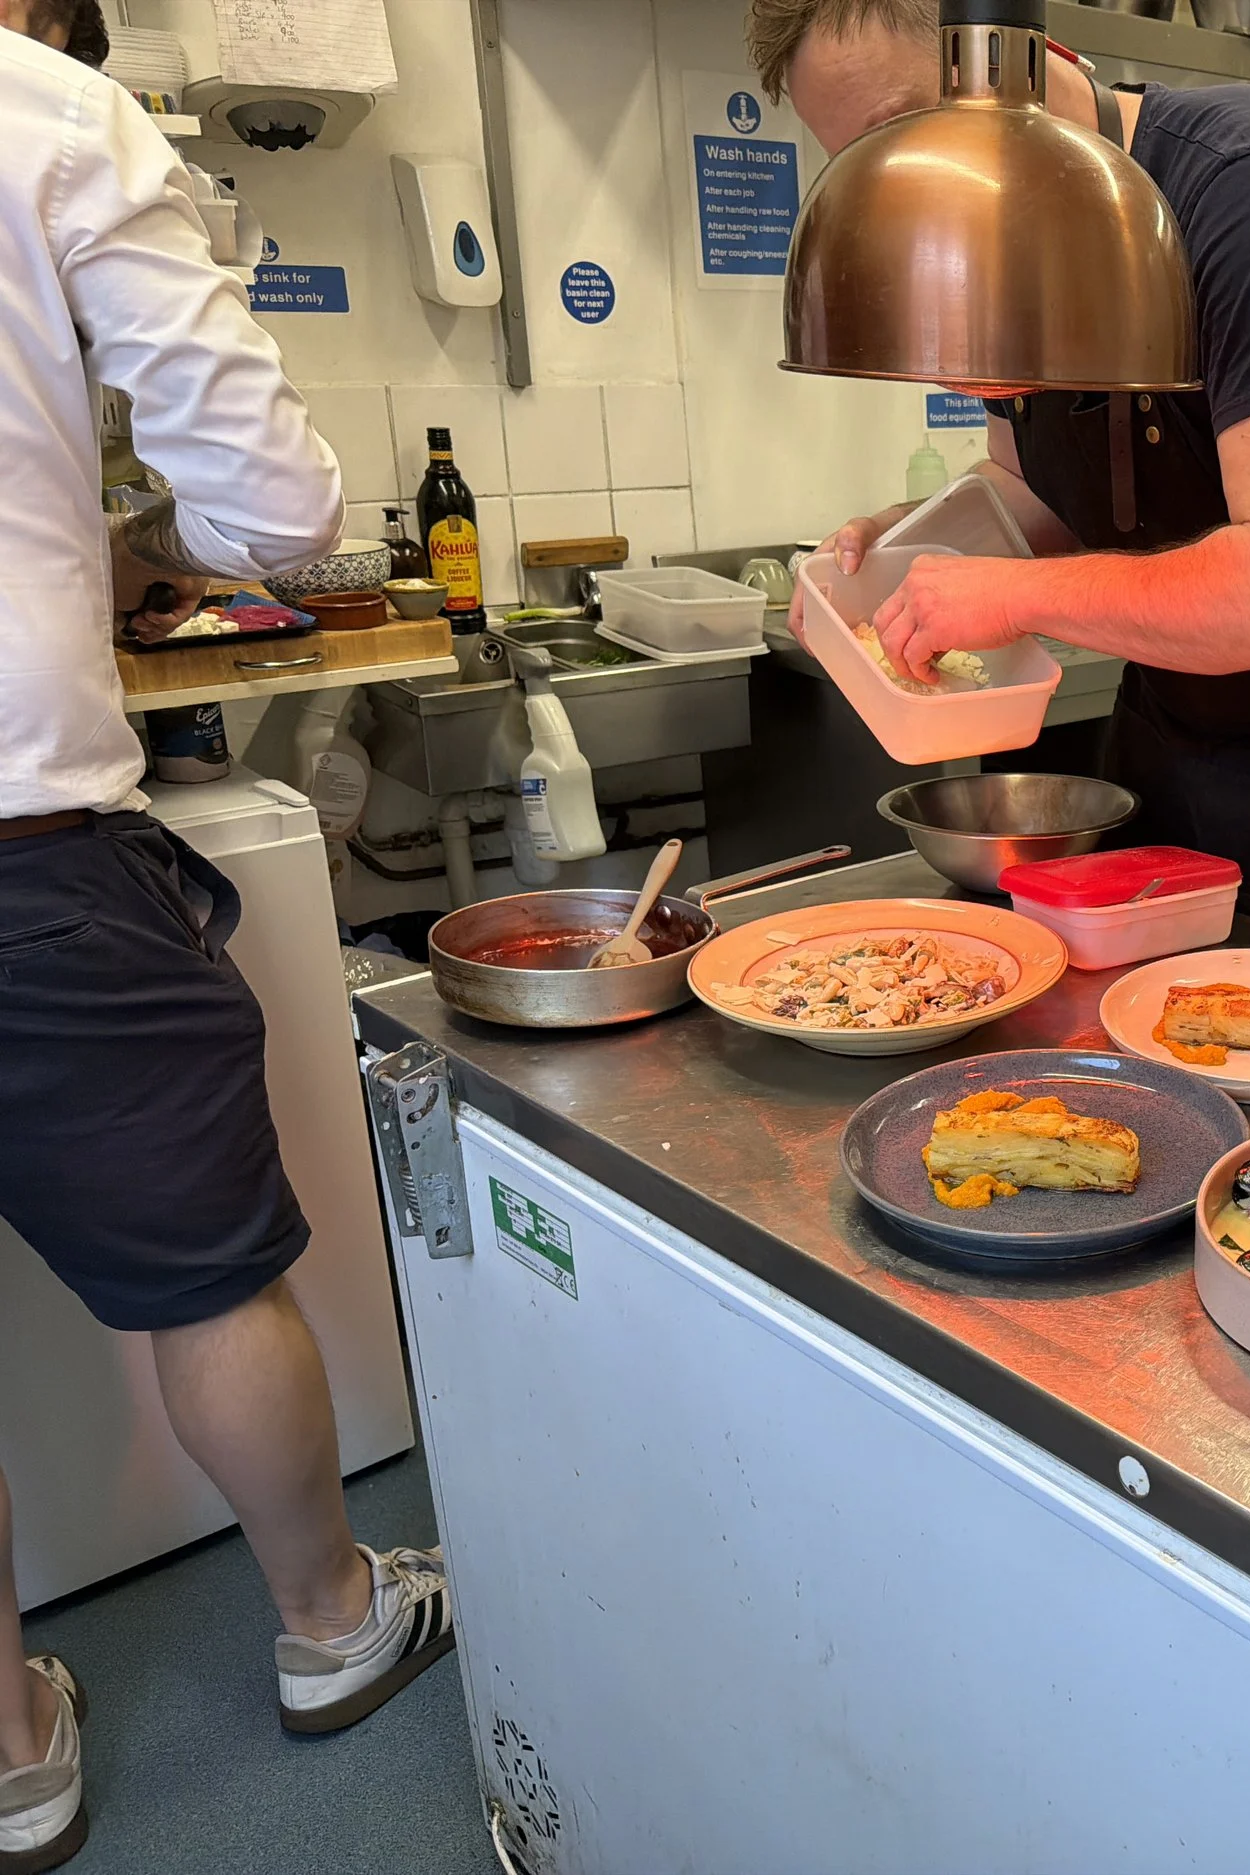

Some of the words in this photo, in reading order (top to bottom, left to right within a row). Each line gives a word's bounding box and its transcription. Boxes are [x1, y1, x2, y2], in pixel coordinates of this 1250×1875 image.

[705, 144, 744, 161] Wash
[747, 148, 788, 165] hands
[703, 168, 715, 177] On
[716, 170, 747, 181] entering
[747, 172, 775, 182] kitchen
[705, 186, 723, 195] After
[723, 188, 742, 197] each
[742, 189, 755, 199] job
[706, 204, 724, 213] After
[725, 205, 758, 217] handling
[759, 208, 773, 216] raw
[773, 208, 790, 217] food
[707, 222, 726, 231] After
[759, 225, 791, 235] cleaning
[707, 231, 746, 241] chemicals
[709, 248, 727, 257] After
[710, 257, 725, 266] etc.
[572, 267, 600, 277] Please
[262, 272, 290, 284] sink
[292, 272, 312, 284] for
[567, 278, 590, 287] leave
[590, 278, 606, 287] this
[565, 288, 588, 298] basin
[589, 289, 611, 298] clean
[258, 291, 294, 303] wash
[296, 292, 324, 306] only
[573, 299, 586, 308] for
[586, 300, 605, 308] next
[580, 311, 600, 319] user
[944, 398, 961, 408] This
[963, 398, 979, 408] sink
[929, 412, 948, 422] food
[948, 413, 987, 424] equipmen
[193, 726, 214, 737] BLACK
